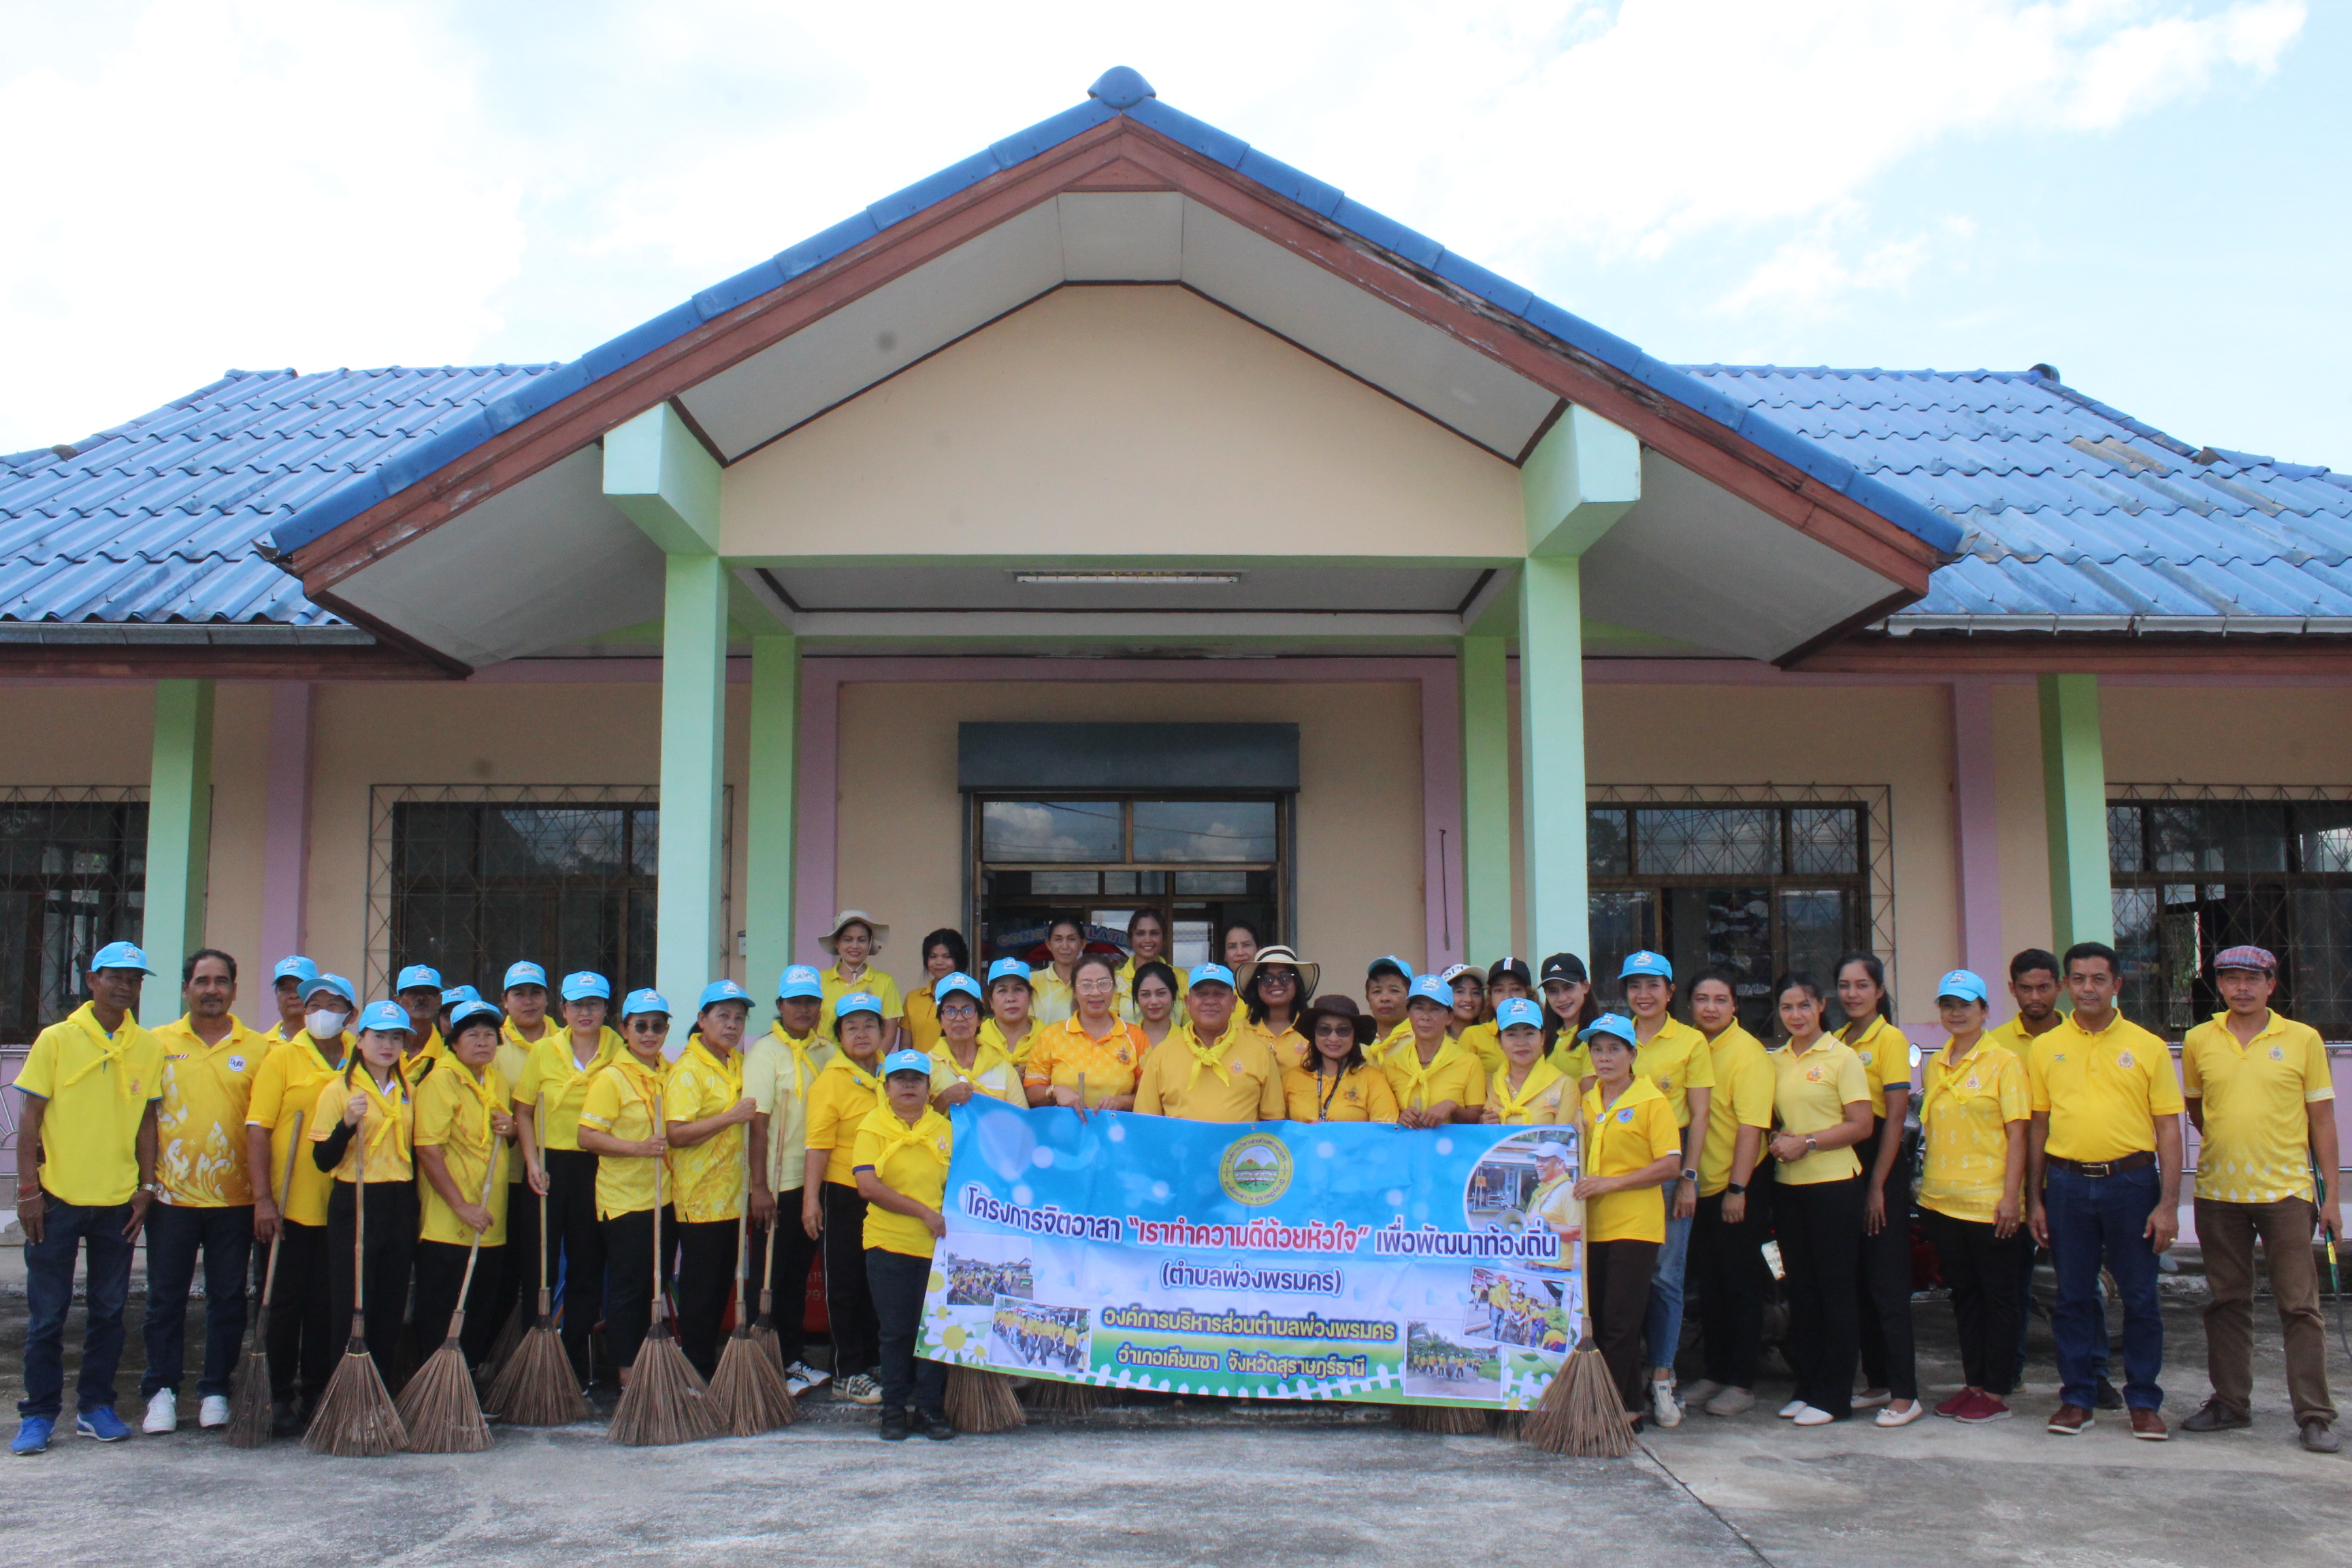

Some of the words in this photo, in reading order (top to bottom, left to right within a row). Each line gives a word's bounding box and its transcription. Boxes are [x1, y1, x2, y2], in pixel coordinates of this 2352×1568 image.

[967, 1186, 1121, 1240] โครงการจิตอาสา
[1376, 1216, 1556, 1256] เพื่อพัฒนาท้องถิ่น
[1162, 1260, 1341, 1294] (ตำบลพ่วงพรมคร)
[1103, 1305, 1396, 1340] องค์การบริหารส่วนตำบลพ่วงพรมคร
[1117, 1344, 1219, 1370] อำเภอเคียนซา
[1228, 1351, 1365, 1379] จังหวัดสุราษฎร์ธานี
